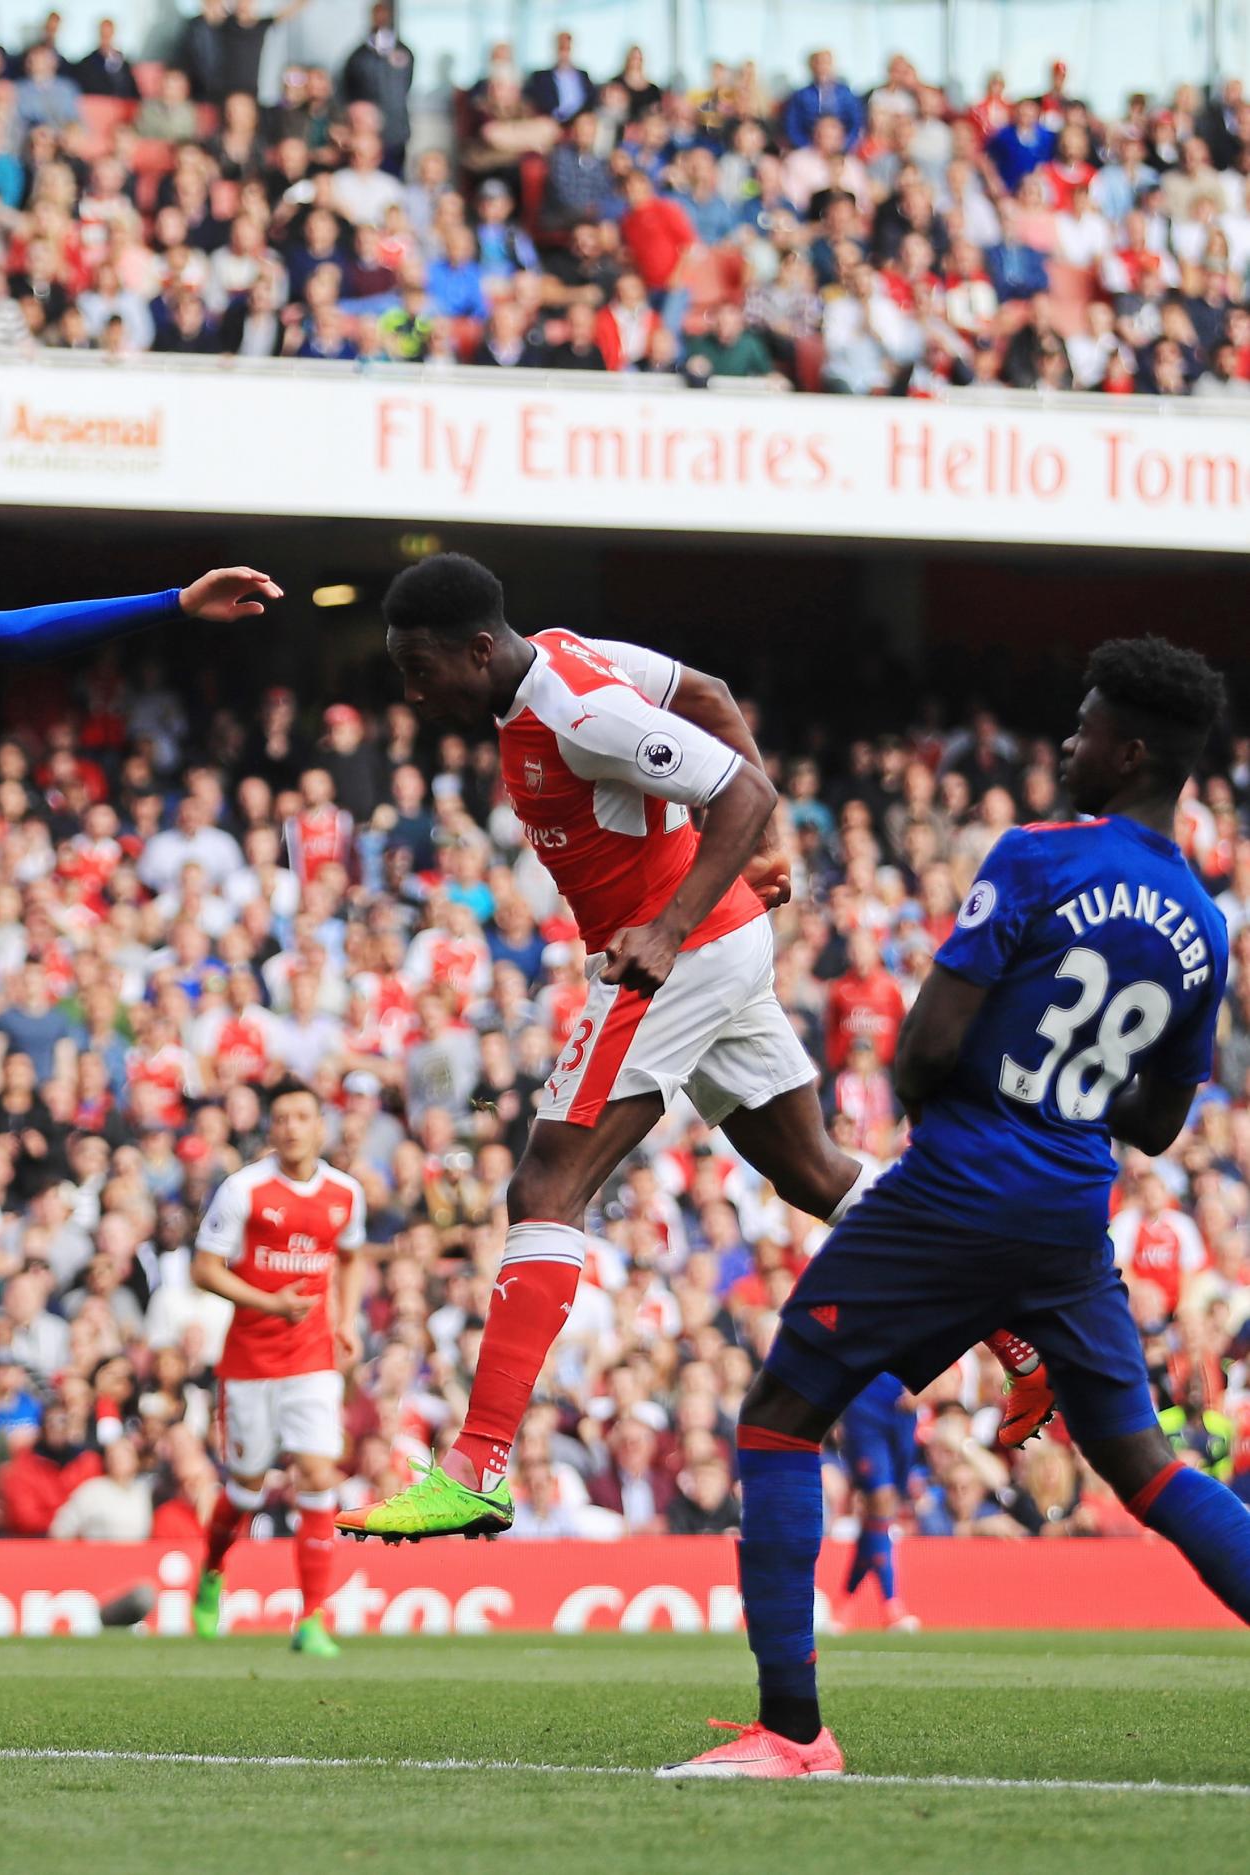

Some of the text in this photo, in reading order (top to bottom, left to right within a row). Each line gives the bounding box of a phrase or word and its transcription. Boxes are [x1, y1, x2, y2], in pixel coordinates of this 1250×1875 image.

[8, 401, 165, 448] Arsenal
[373, 399, 1250, 509] Fly Emirates. Hello Tom
[1055, 882, 1211, 991] TUANZEBE
[998, 946, 1172, 1121] 38
